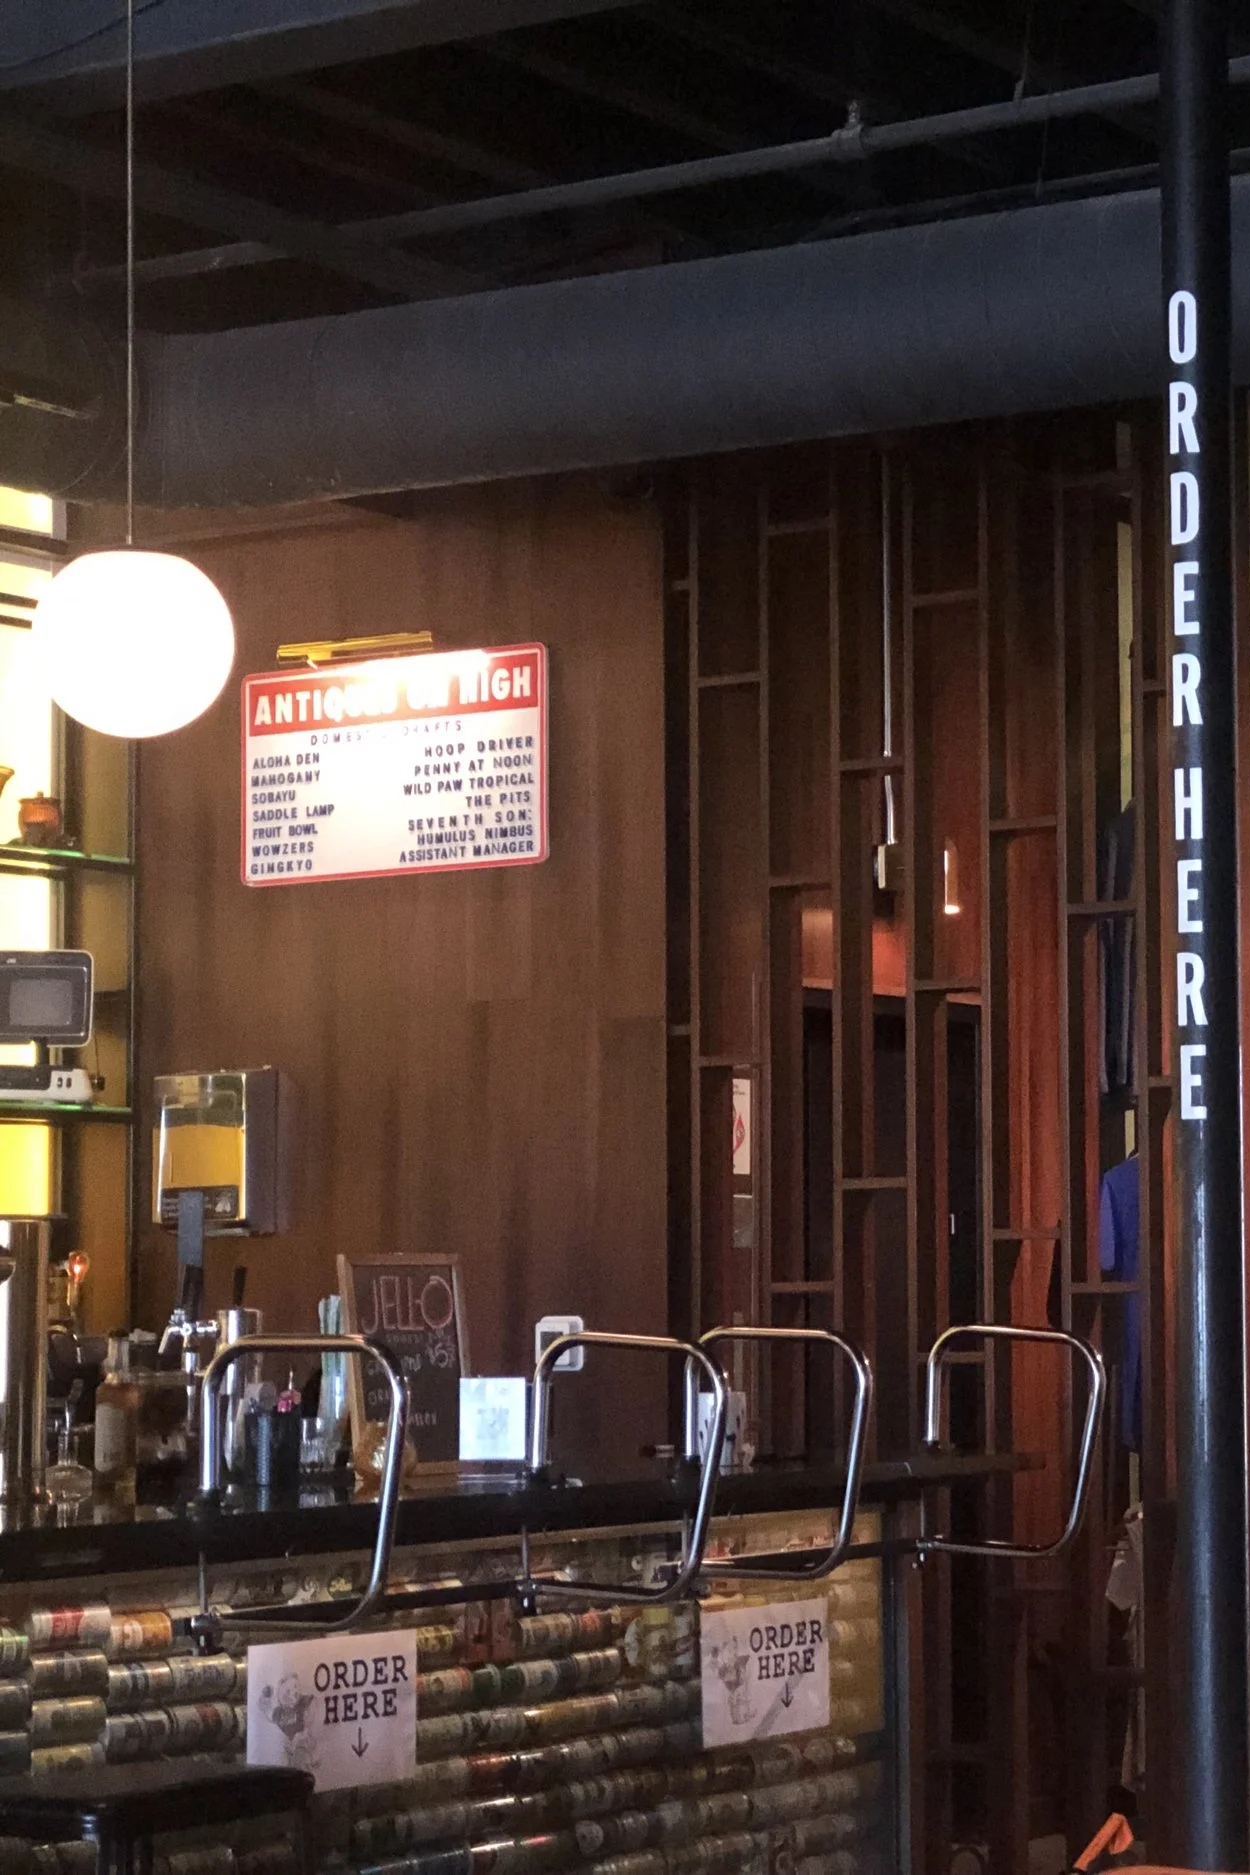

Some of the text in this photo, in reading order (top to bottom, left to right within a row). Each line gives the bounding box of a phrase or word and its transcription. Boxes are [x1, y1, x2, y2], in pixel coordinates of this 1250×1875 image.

[254, 681, 398, 726] ANTIQ
[1168, 290, 1208, 1120] ORDER HERE
[310, 729, 387, 747] DOMES
[424, 735, 533, 758] HOOP DRIVER
[253, 752, 320, 770] ALOHA DEN
[414, 754, 532, 777] PENNY AT NOON
[251, 770, 320, 787] MAHOGANY
[403, 772, 535, 796] WILD PAW TROPICAL
[252, 790, 296, 805] SOBAYU
[466, 791, 530, 808] THE PITS
[252, 804, 335, 822] SADDLE LAMP
[408, 813, 483, 832] SEVENTH
[252, 824, 318, 840] FRUIT BOWL
[417, 824, 533, 846] HUMULUS NIMBUS
[252, 841, 314, 857] WOWZERS
[400, 840, 534, 863] ASSISTANT MANAGER
[250, 859, 312, 875] GINGKYO
[750, 1620, 823, 1653] ORDER
[314, 1655, 408, 1692] ORDER
[758, 1648, 815, 1680] HERE
[324, 1688, 398, 1724] HERE
